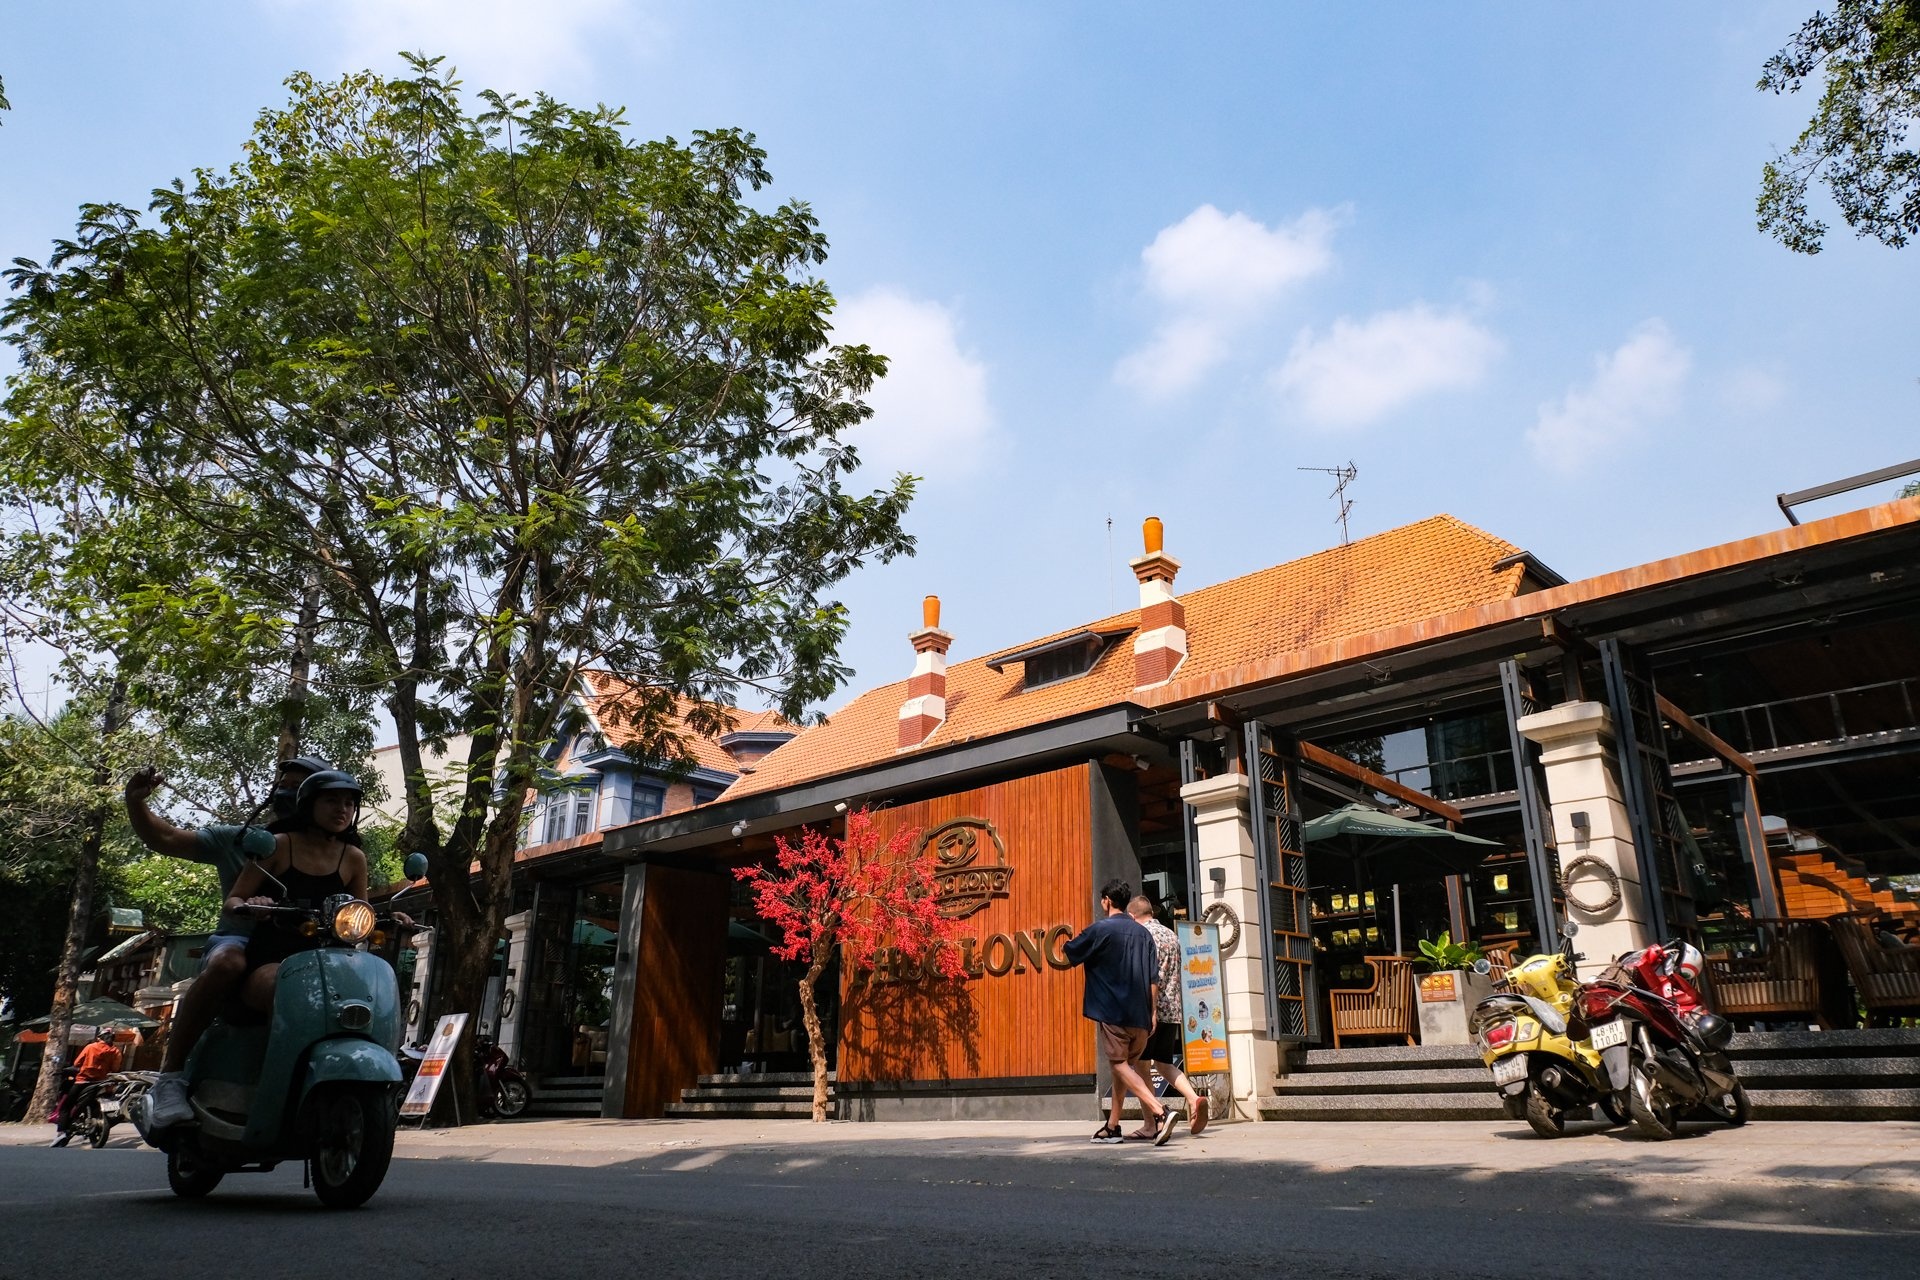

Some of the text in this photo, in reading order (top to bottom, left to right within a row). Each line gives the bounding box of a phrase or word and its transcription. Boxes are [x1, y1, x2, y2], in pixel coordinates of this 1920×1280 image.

[959, 872, 1006, 891] LONG
[961, 924, 1075, 977] LONG
[1596, 1023, 1618, 1037] 48-H1
[1594, 1031, 1624, 1049] 110.02
